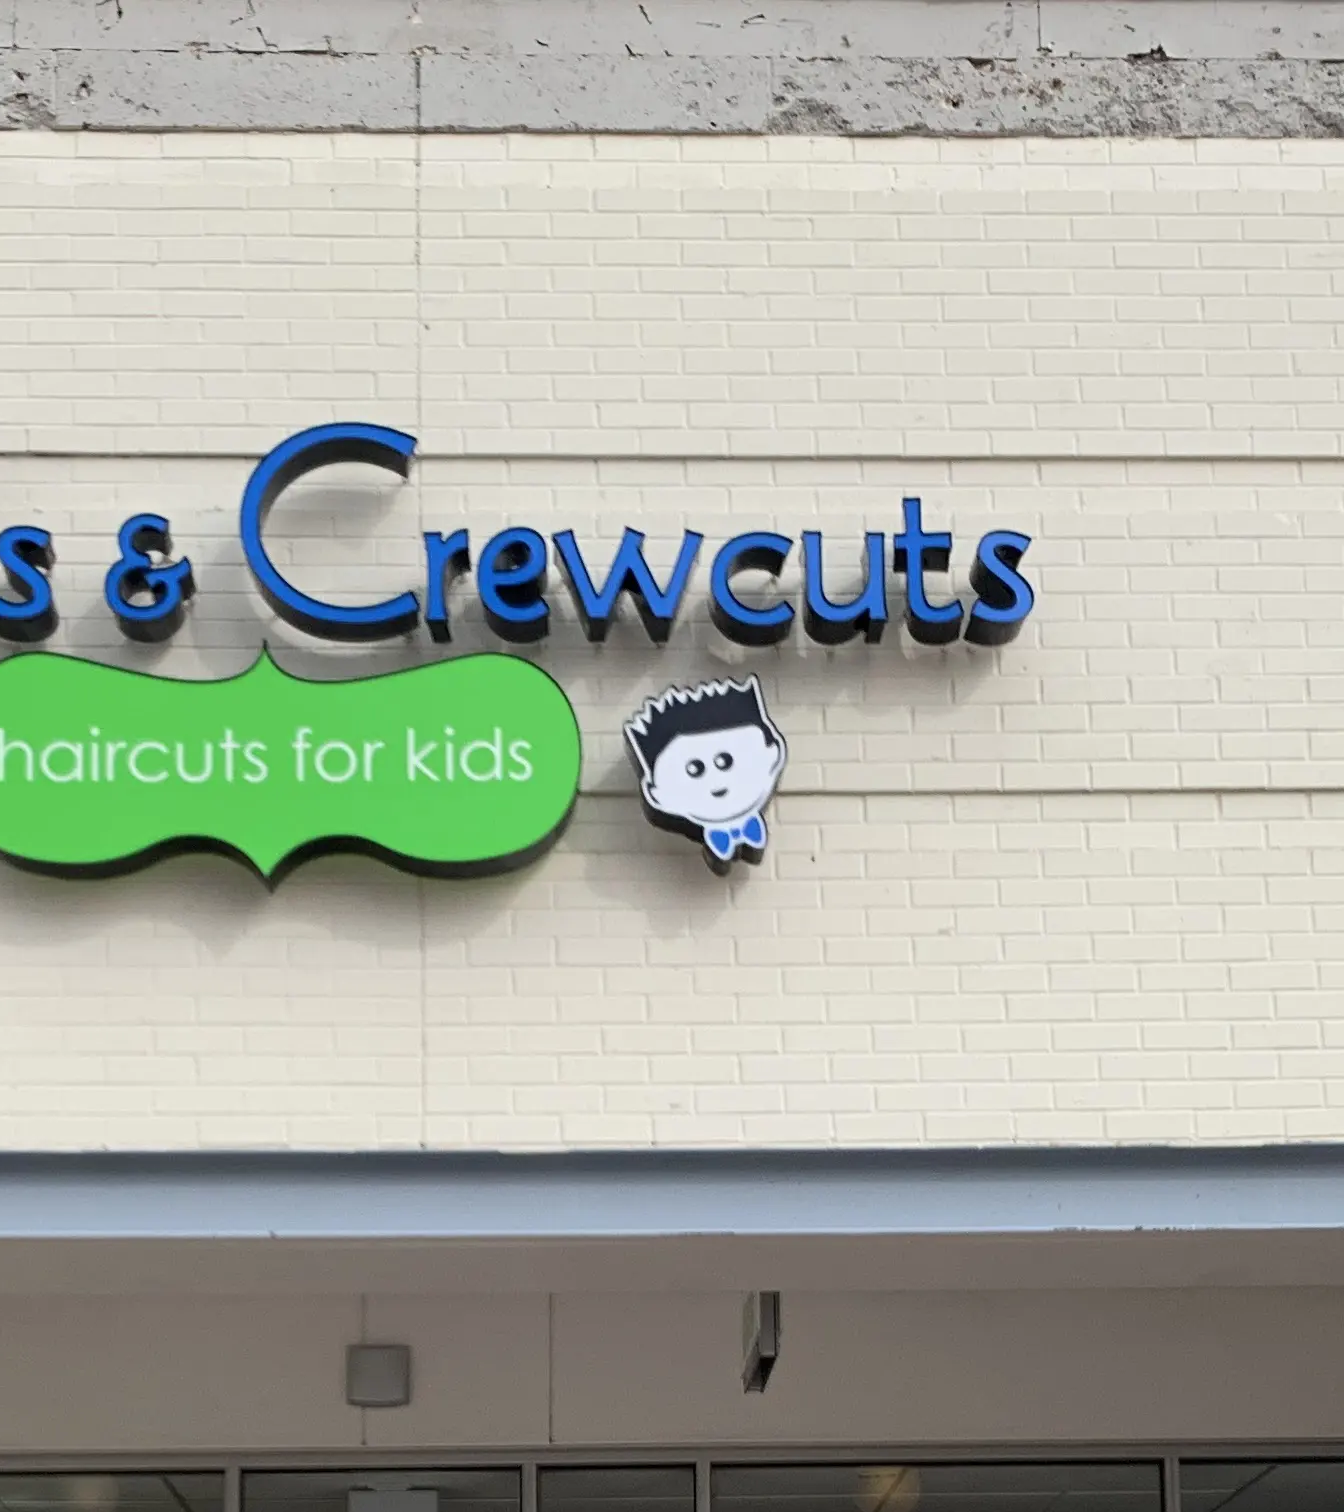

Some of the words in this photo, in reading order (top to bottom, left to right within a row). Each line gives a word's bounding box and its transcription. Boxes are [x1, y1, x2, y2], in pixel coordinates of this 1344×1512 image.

[104, 512, 194, 625] &
[240, 421, 1035, 632] Crewcuts
[290, 727, 385, 783] for
[407, 727, 535, 783] kids
